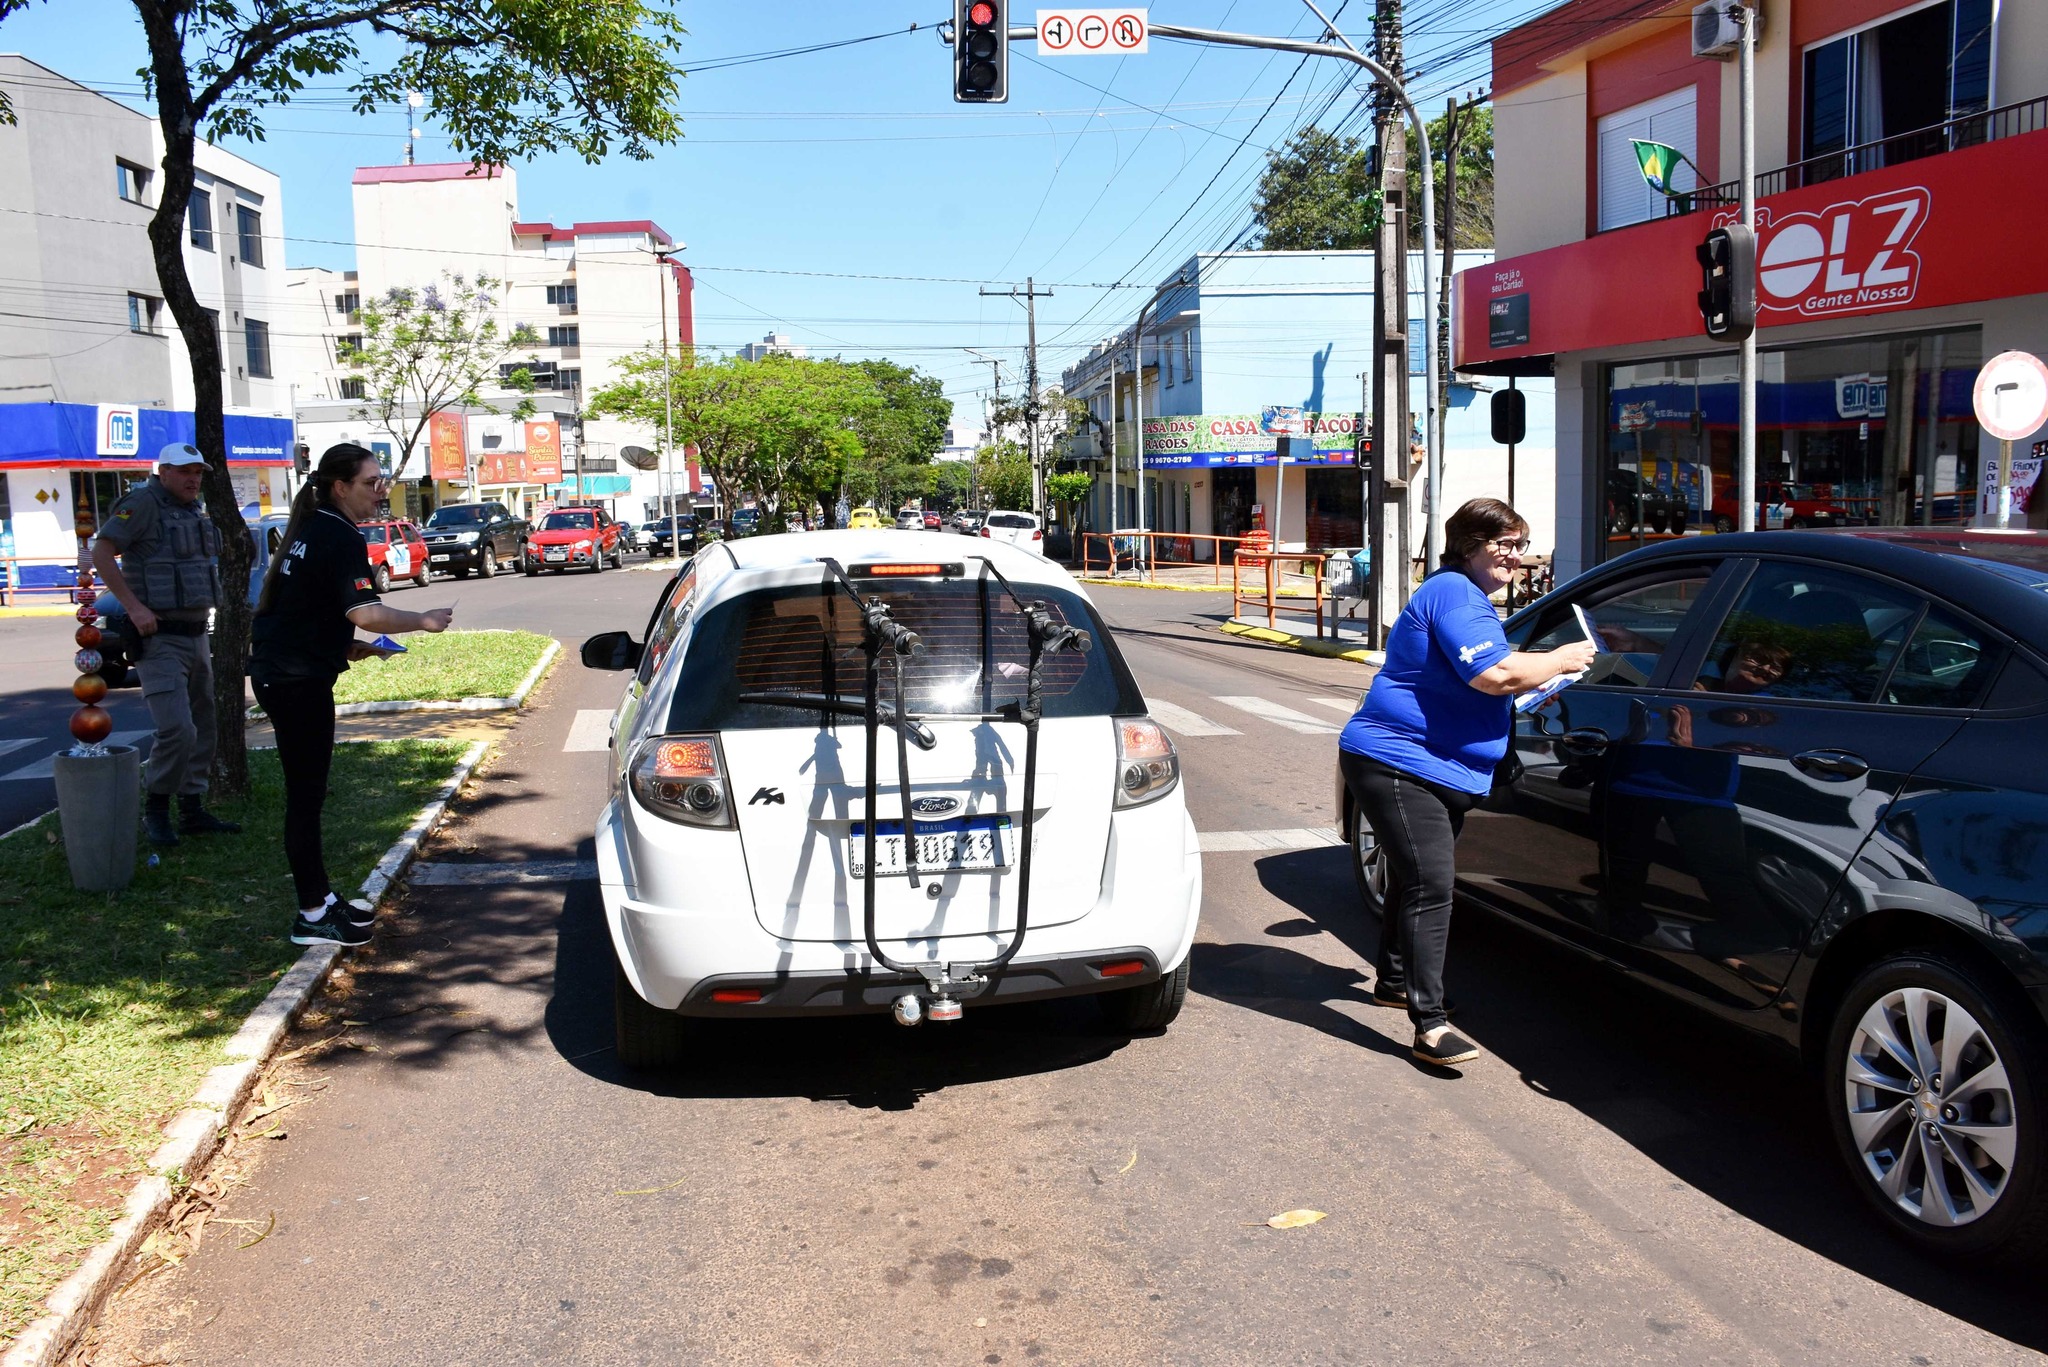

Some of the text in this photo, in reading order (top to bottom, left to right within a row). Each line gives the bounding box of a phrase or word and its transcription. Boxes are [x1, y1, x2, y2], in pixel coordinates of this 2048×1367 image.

[1495, 272, 1508, 282] Faça
[1508, 269, 1515, 281] já
[1492, 278, 1524, 293] seu Cartão!
[1805, 285, 1908, 310] Gente Nossa
[1170, 421, 1195, 433] DAS
[1210, 420, 1259, 436] CASA
[1145, 435, 1189, 450] RAÇÕES
[528, 444, 554, 456] Santa
[532, 453, 558, 462] Pizza
[1475, 640, 1494, 653] SUS
[919, 797, 949, 811] Ford
[919, 824, 946, 832] BRASIL
[855, 863, 865, 873] BR
